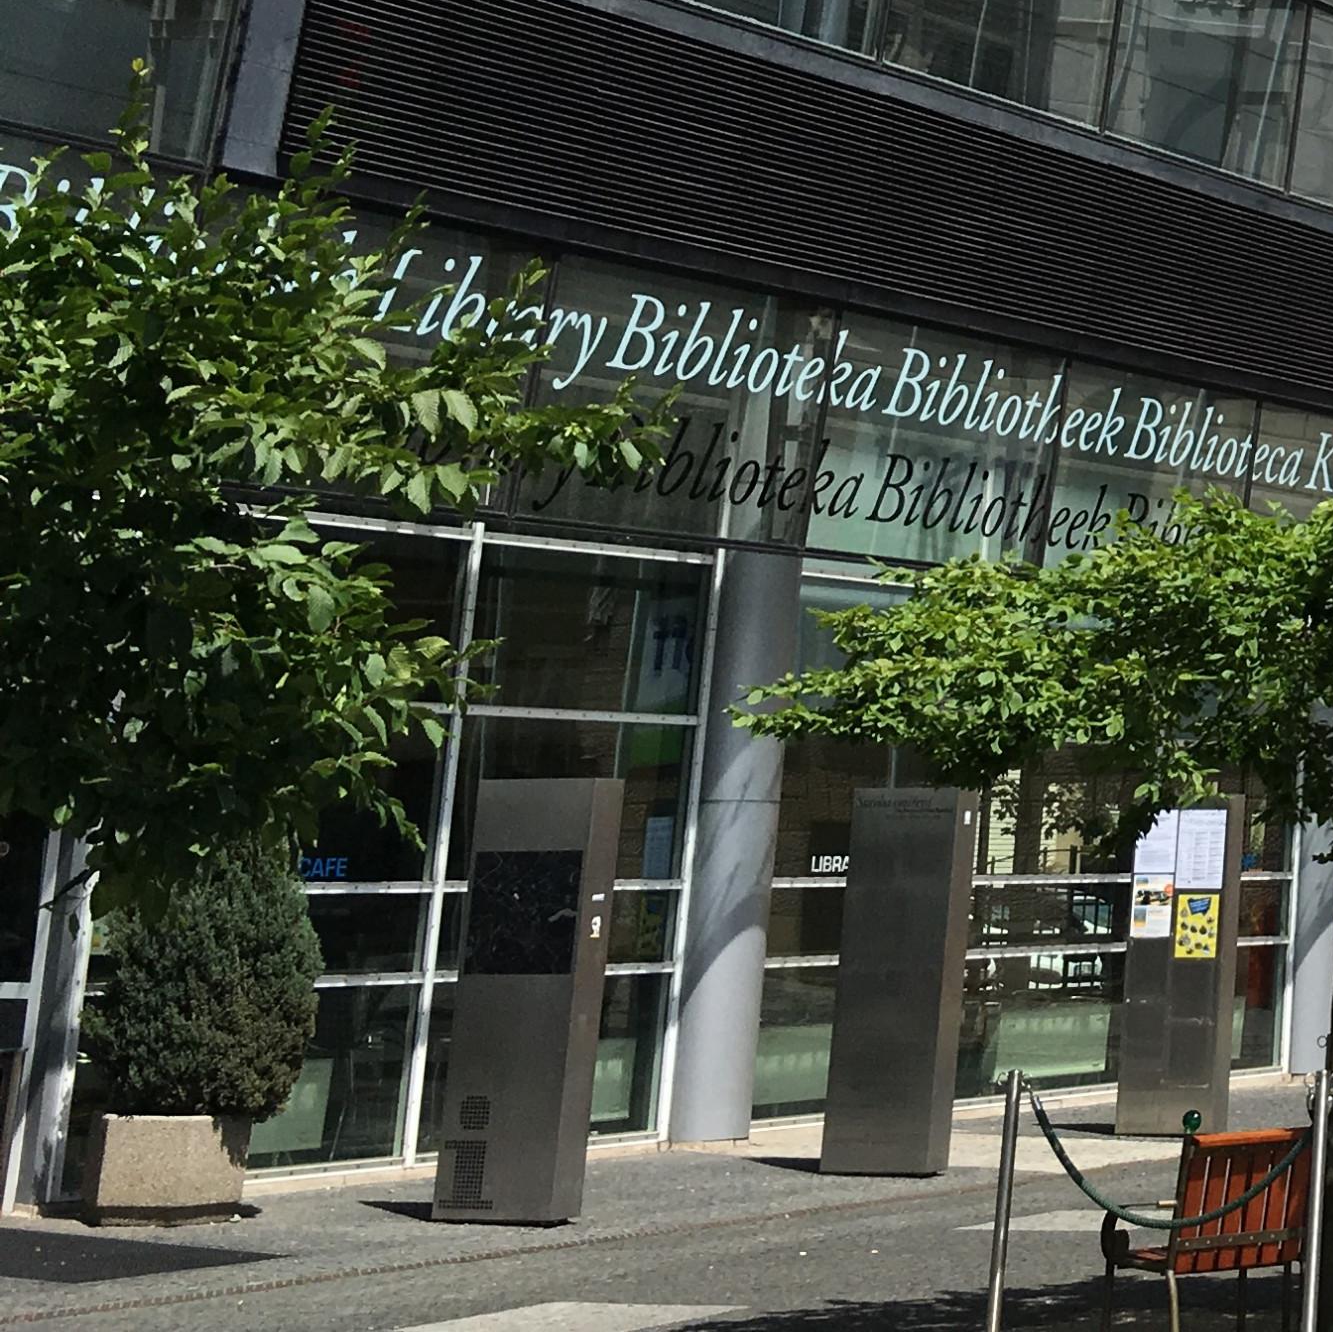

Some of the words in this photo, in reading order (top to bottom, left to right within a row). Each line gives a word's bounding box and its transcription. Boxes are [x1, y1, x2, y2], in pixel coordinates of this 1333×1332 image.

[605, 294, 882, 412] Biblioteka
[882, 348, 1125, 456] Bibliotheek
[1124, 397, 1303, 487] Biblioteca
